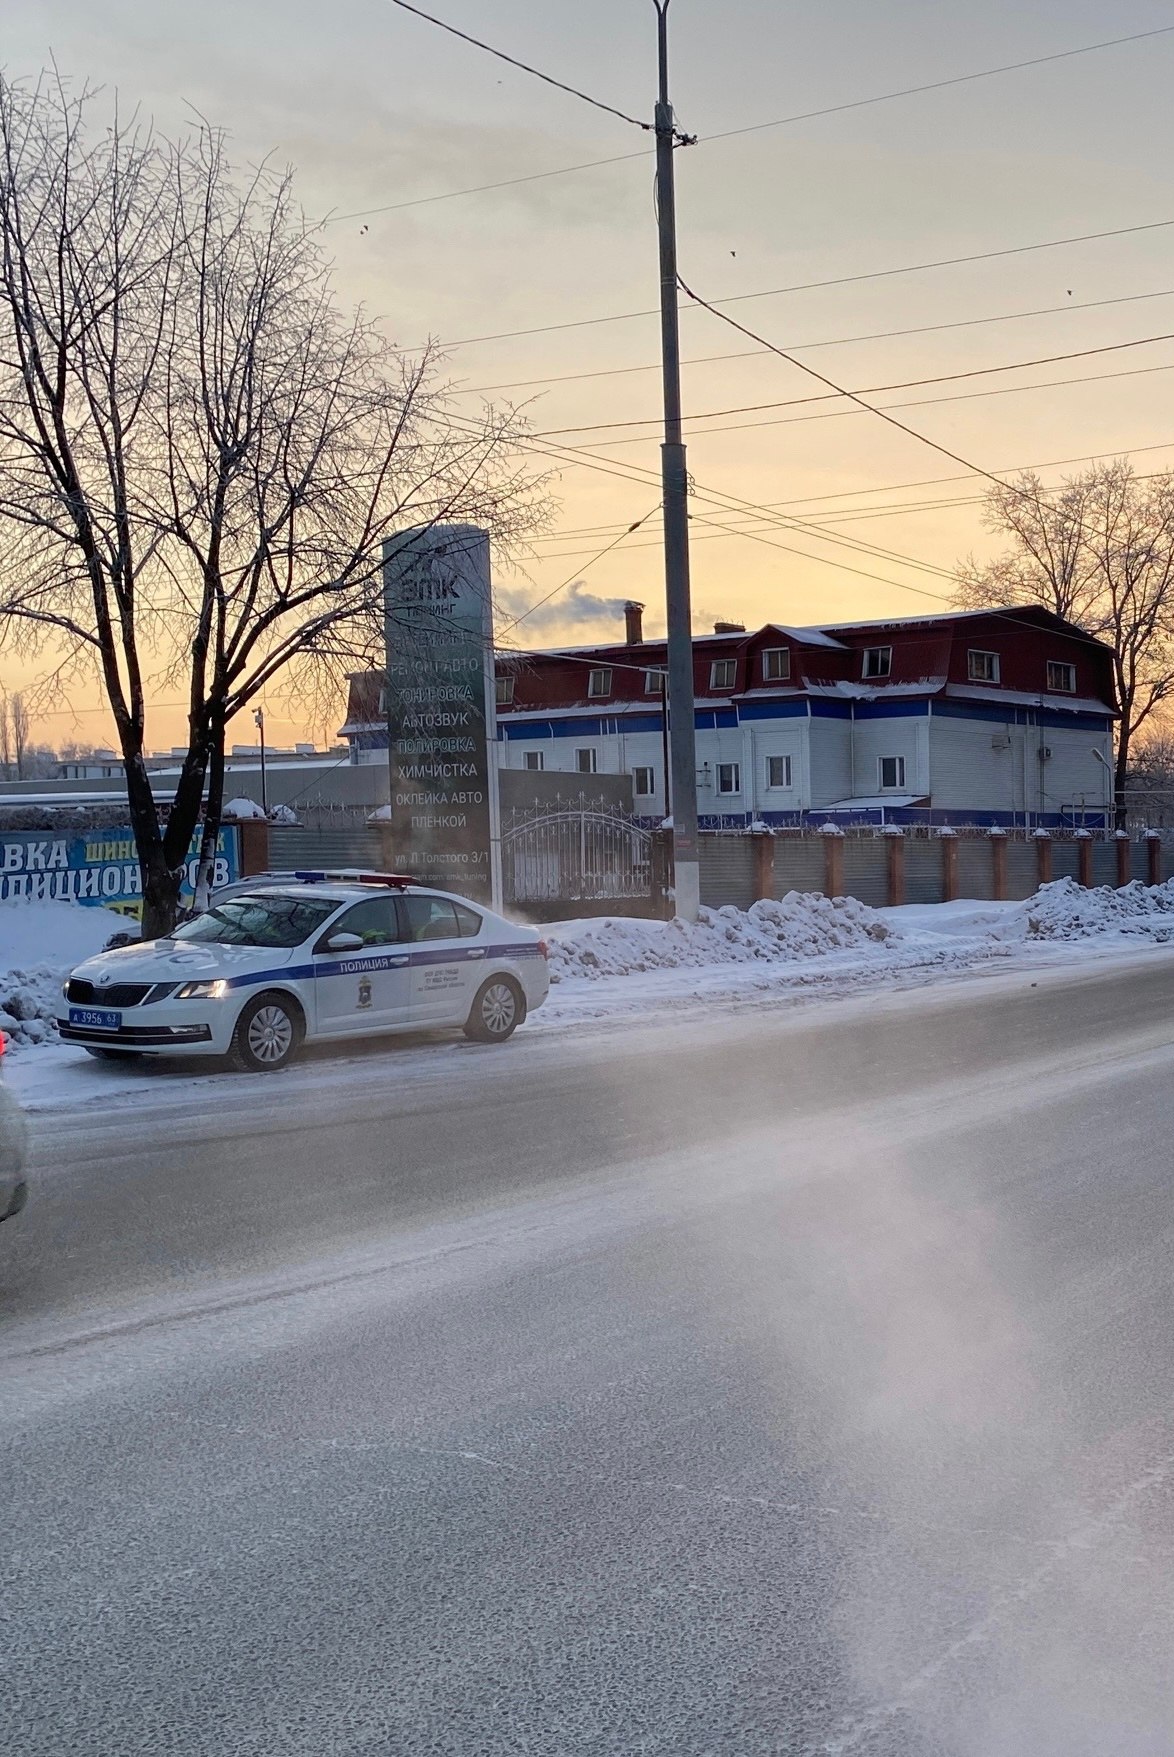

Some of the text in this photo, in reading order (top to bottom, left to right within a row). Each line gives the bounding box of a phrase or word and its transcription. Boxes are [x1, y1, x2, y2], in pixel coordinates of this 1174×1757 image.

[398, 685, 474, 703] ТОНИРОВКА
[402, 712, 469, 728] АВТОЗВУК
[397, 736, 476, 754] ПОЛИРОВКА
[398, 762, 478, 779] ХИМЧИСТКА
[396, 790, 483, 806] ОКЛЕЙКА АВТО
[411, 813, 467, 828] ПЛЕНКОЙ
[0, 840, 69, 872] ВКА
[471, 851, 489, 863] 3/1
[340, 958, 389, 973] ПОЛИЦИЯ
[107, 1013, 116, 1023] 63
